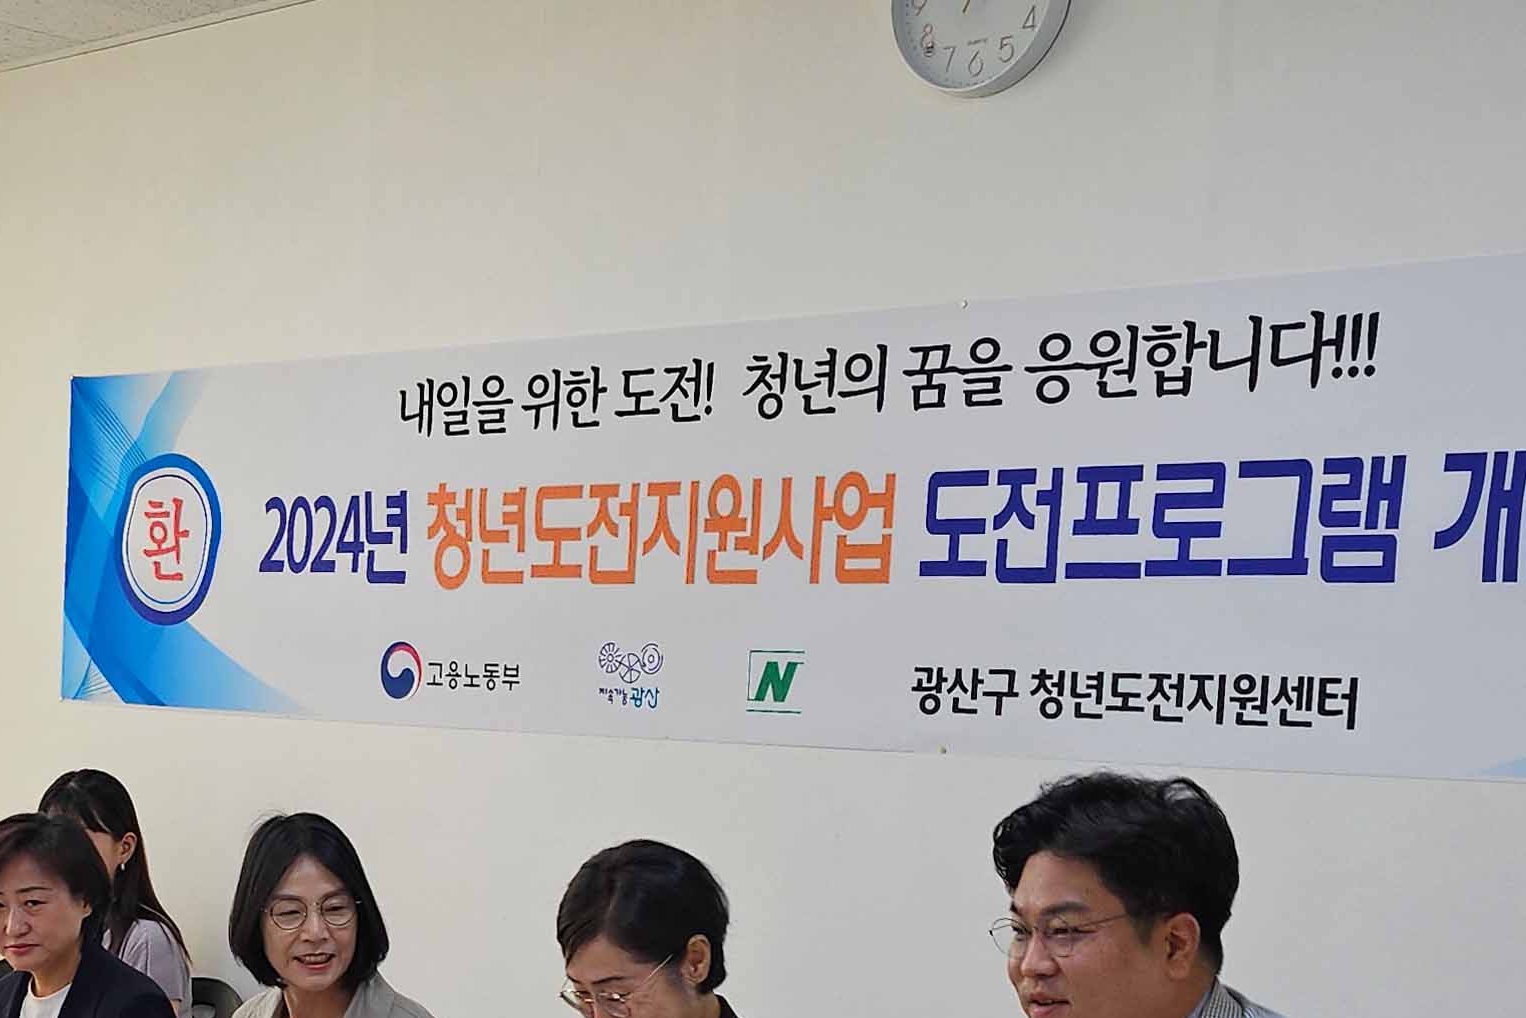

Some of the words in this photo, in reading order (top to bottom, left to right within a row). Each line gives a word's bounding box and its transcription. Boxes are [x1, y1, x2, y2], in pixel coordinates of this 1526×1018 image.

[1021, 6, 1037, 31] 4
[943, 46, 956, 73] 7
[968, 50, 984, 77] 6
[999, 35, 1015, 63] 5
[398, 373, 514, 438] 내일을
[521, 366, 607, 431] 위한
[614, 357, 715, 424] 도전!
[742, 343, 888, 418] 청년의
[902, 336, 1014, 412] 꿈을
[1024, 310, 1380, 404] 응원합니다!!!
[259, 490, 409, 585] 2024년
[426, 471, 896, 589] 청년도전지원사업
[919, 454, 1407, 584] 도전프로그램
[1433, 450, 1526, 583] 개
[142, 496, 190, 583] 환
[426, 660, 521, 691] 고용노동부
[630, 687, 660, 709] 광산
[910, 666, 1019, 718] 광산구
[1029, 667, 1360, 730] 청년도전지원센터
